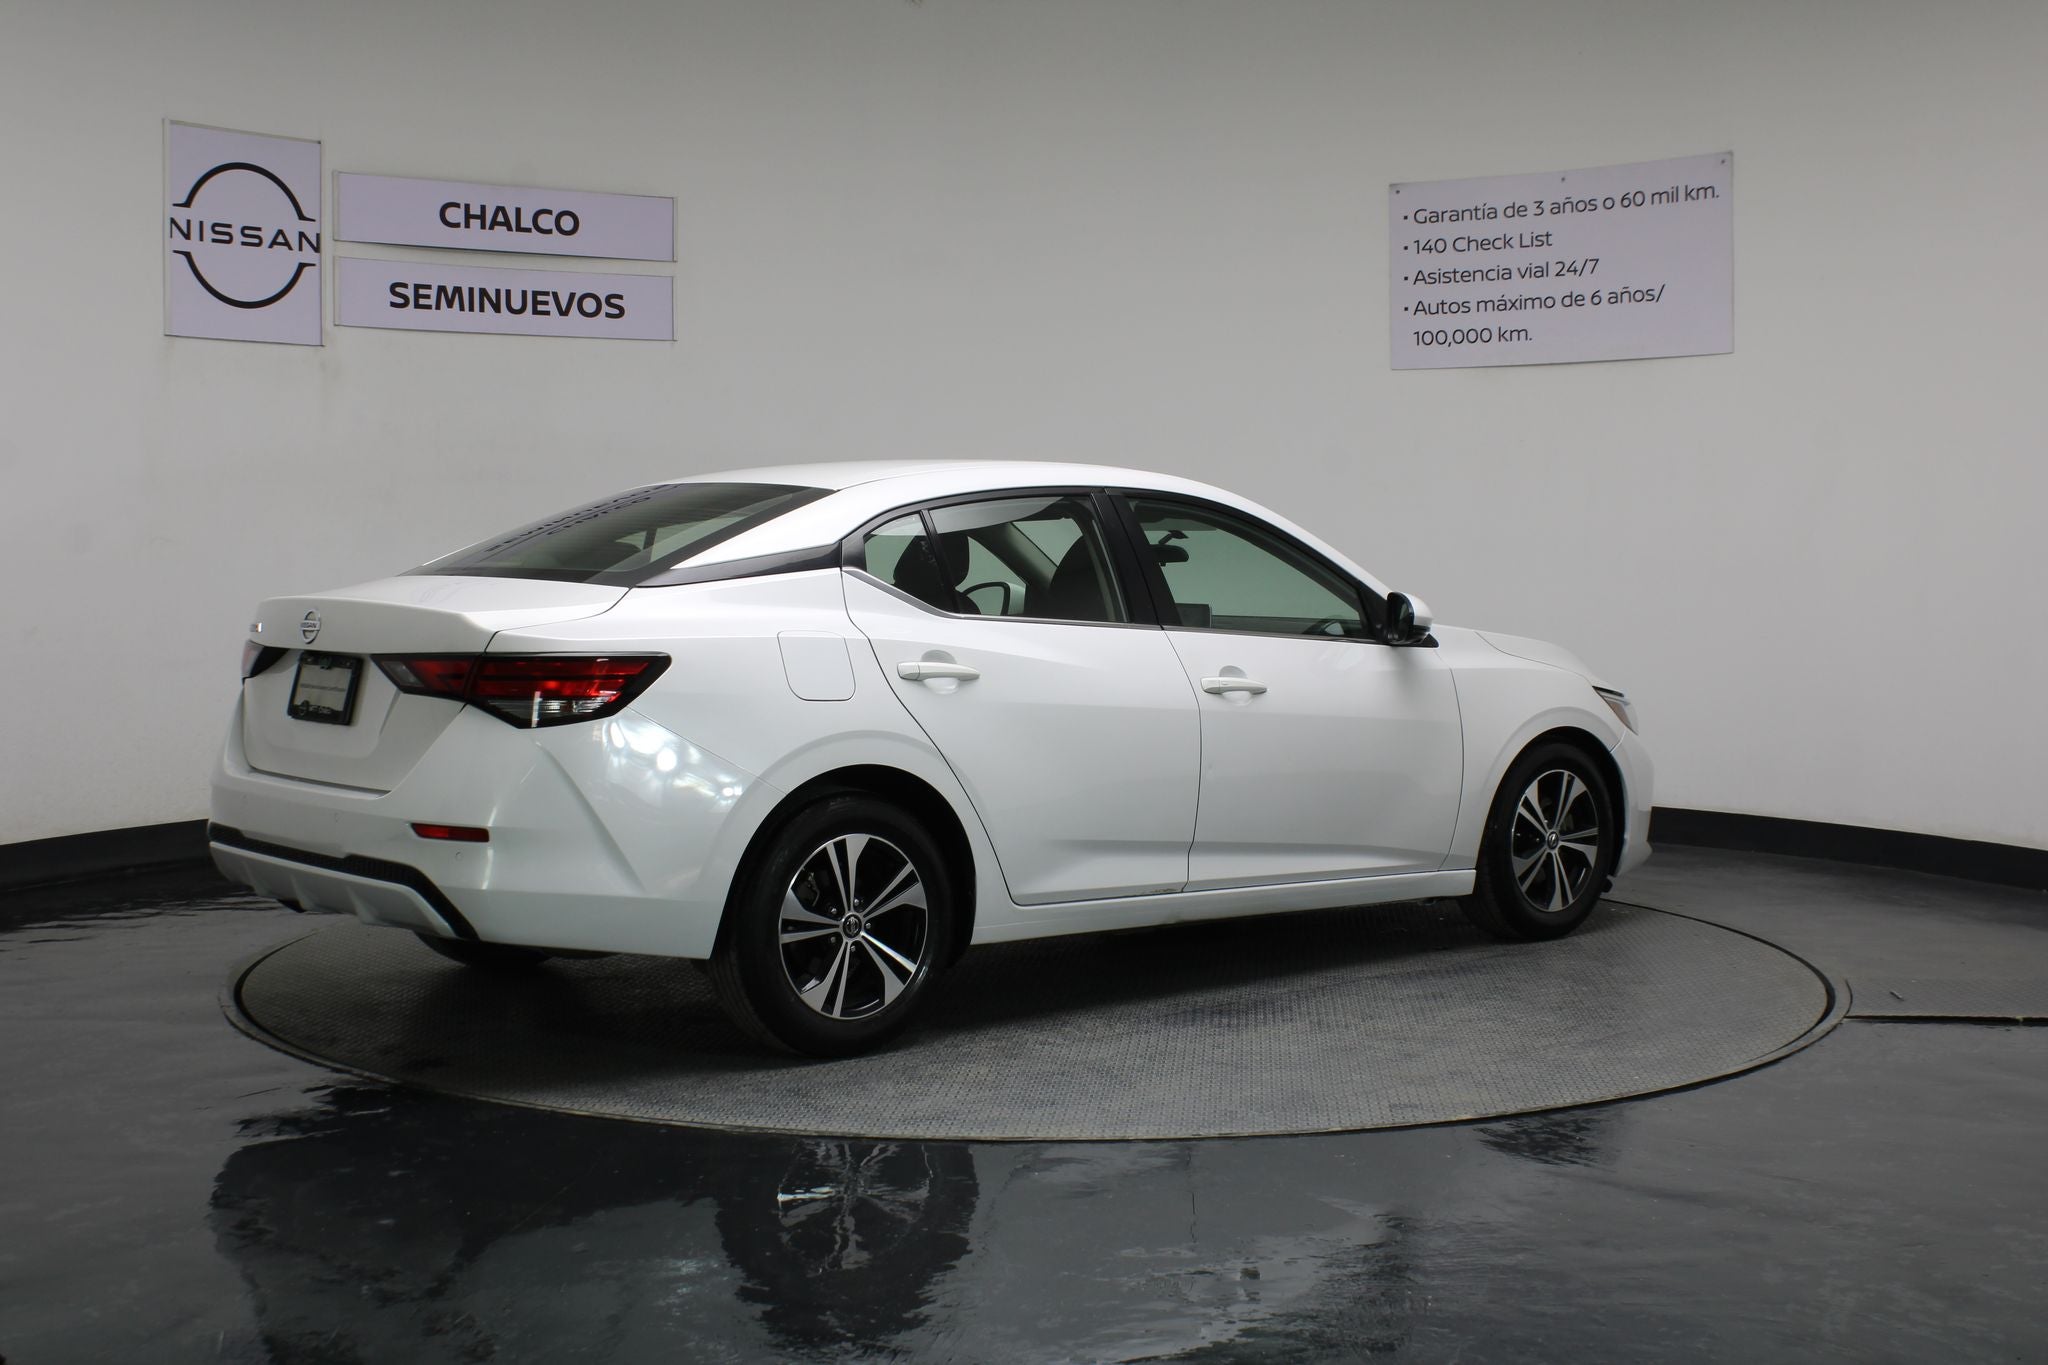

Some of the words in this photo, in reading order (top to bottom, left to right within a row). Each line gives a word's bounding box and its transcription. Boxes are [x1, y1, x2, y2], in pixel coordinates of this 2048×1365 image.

[439, 201, 580, 237] CHALCO
[1413, 202, 1498, 225] Garantía
[1503, 201, 1529, 219] de
[1532, 200, 1545, 217] 3
[1549, 196, 1598, 216] años
[1602, 196, 1616, 211] o
[1620, 190, 1646, 209] 60
[1650, 185, 1680, 206] mil
[1684, 184, 1720, 202] km.
[169, 216, 321, 254] NISSAN
[1413, 237, 1448, 255] 140
[1452, 233, 1515, 253] Check
[1519, 231, 1553, 249] List
[1412, 264, 1513, 286] Asistencia
[1516, 261, 1550, 280] vial
[1554, 257, 1600, 278] 24/7
[389, 281, 626, 320] SEMINUEVOS
[1413, 299, 1472, 316] Autos
[1476, 293, 1556, 313] máximo
[1560, 290, 1586, 308] de
[1590, 289, 1602, 306] 6
[1607, 283, 1666, 305] años/
[1413, 327, 1493, 348] 100,000
[1498, 326, 1533, 343] km.
